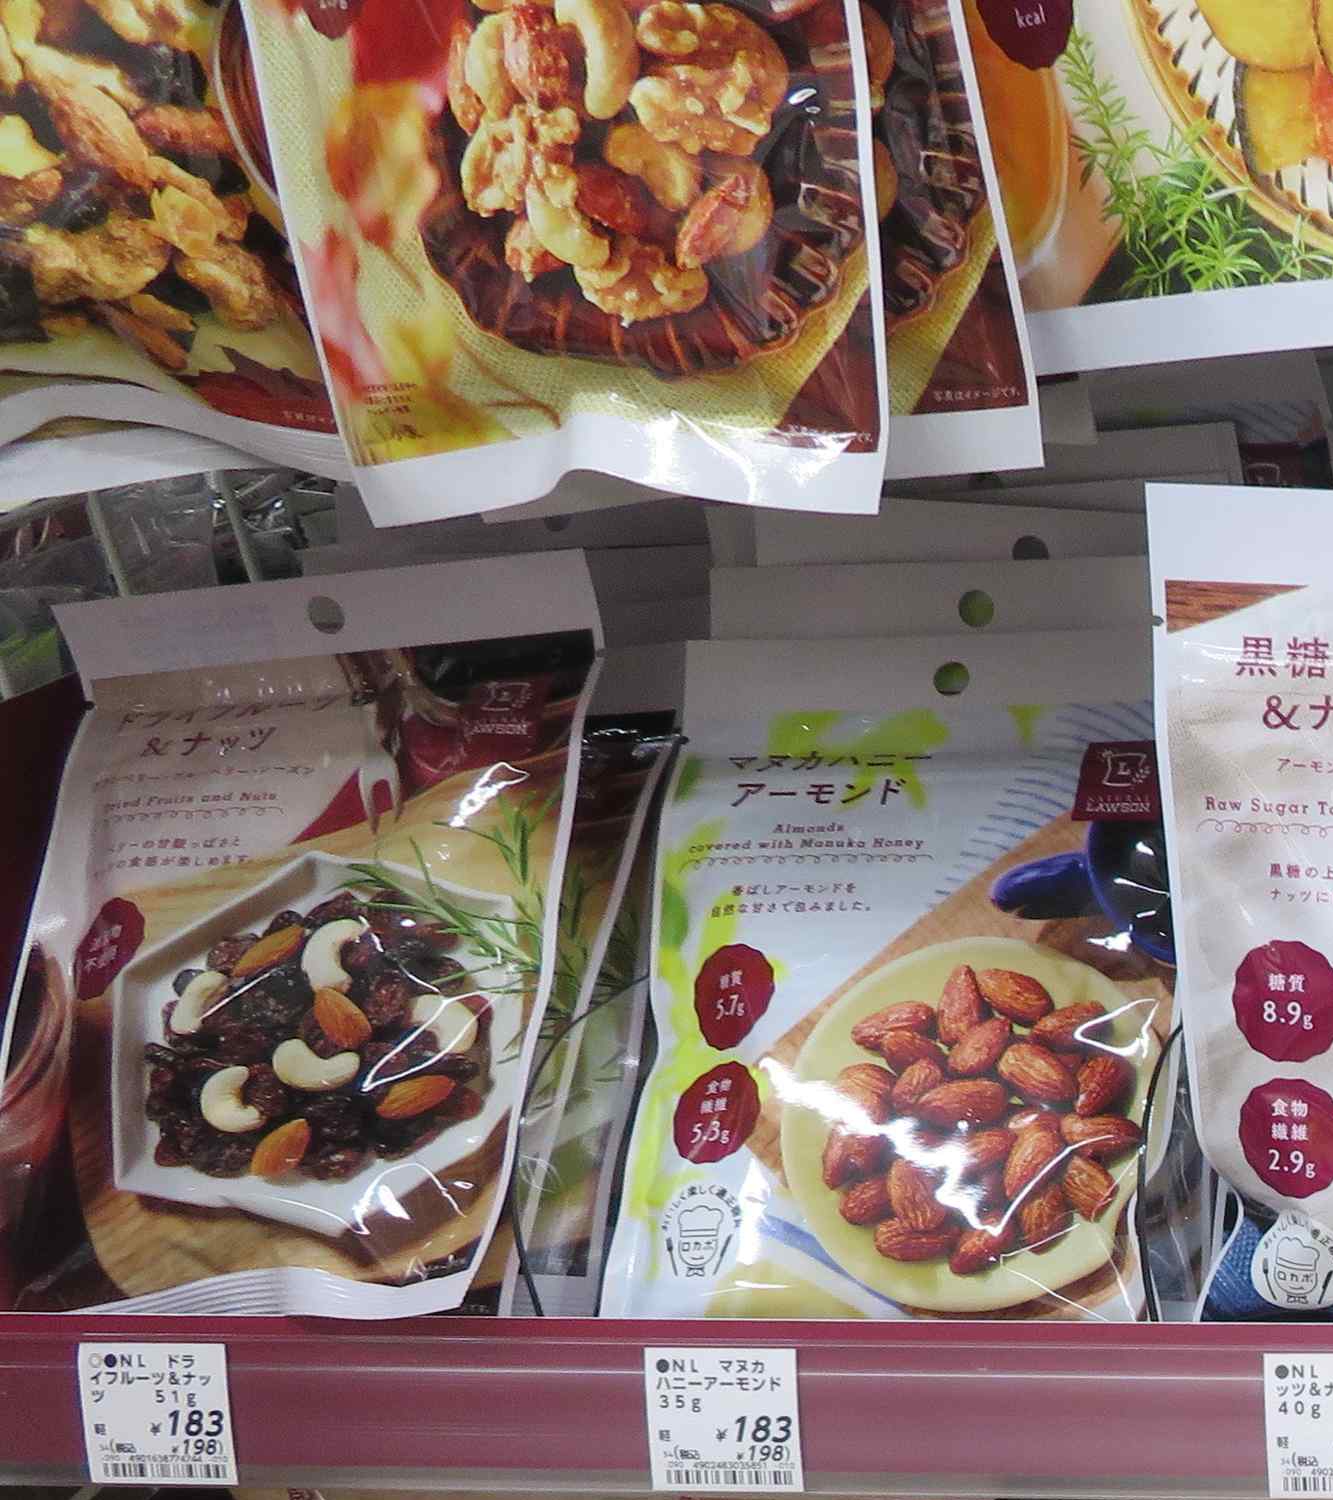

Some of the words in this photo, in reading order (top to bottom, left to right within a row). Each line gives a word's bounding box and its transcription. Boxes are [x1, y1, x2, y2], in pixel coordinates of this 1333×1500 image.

[1015, 8, 1046, 27] kcal
[730, 779, 906, 807] アーモンド
[1205, 796, 1242, 814] Raw
[1250, 798, 1310, 818] Sugar
[772, 822, 845, 833] Almonds
[759, 835, 793, 849] with
[872, 839, 923, 850] Honey
[1267, 973, 1306, 994] 糖質
[1262, 1001, 1314, 1031] 8.9g
[1271, 1099, 1309, 1118] 食物
[690, 1122, 731, 1146] 5.3g
[1271, 1123, 1309, 1142] 繊維
[1268, 1150, 1316, 1179] 2.9g
[168, 1354, 195, 1368] ドラ
[719, 1360, 765, 1374] マヌカ
[90, 1371, 211, 1386] イフルーツ&ナッ
[656, 1377, 781, 1391] ハニーアーモンド
[155, 1390, 197, 1408] 51g
[659, 1395, 702, 1413] 35g
[1278, 1401, 1321, 1419] 40g
